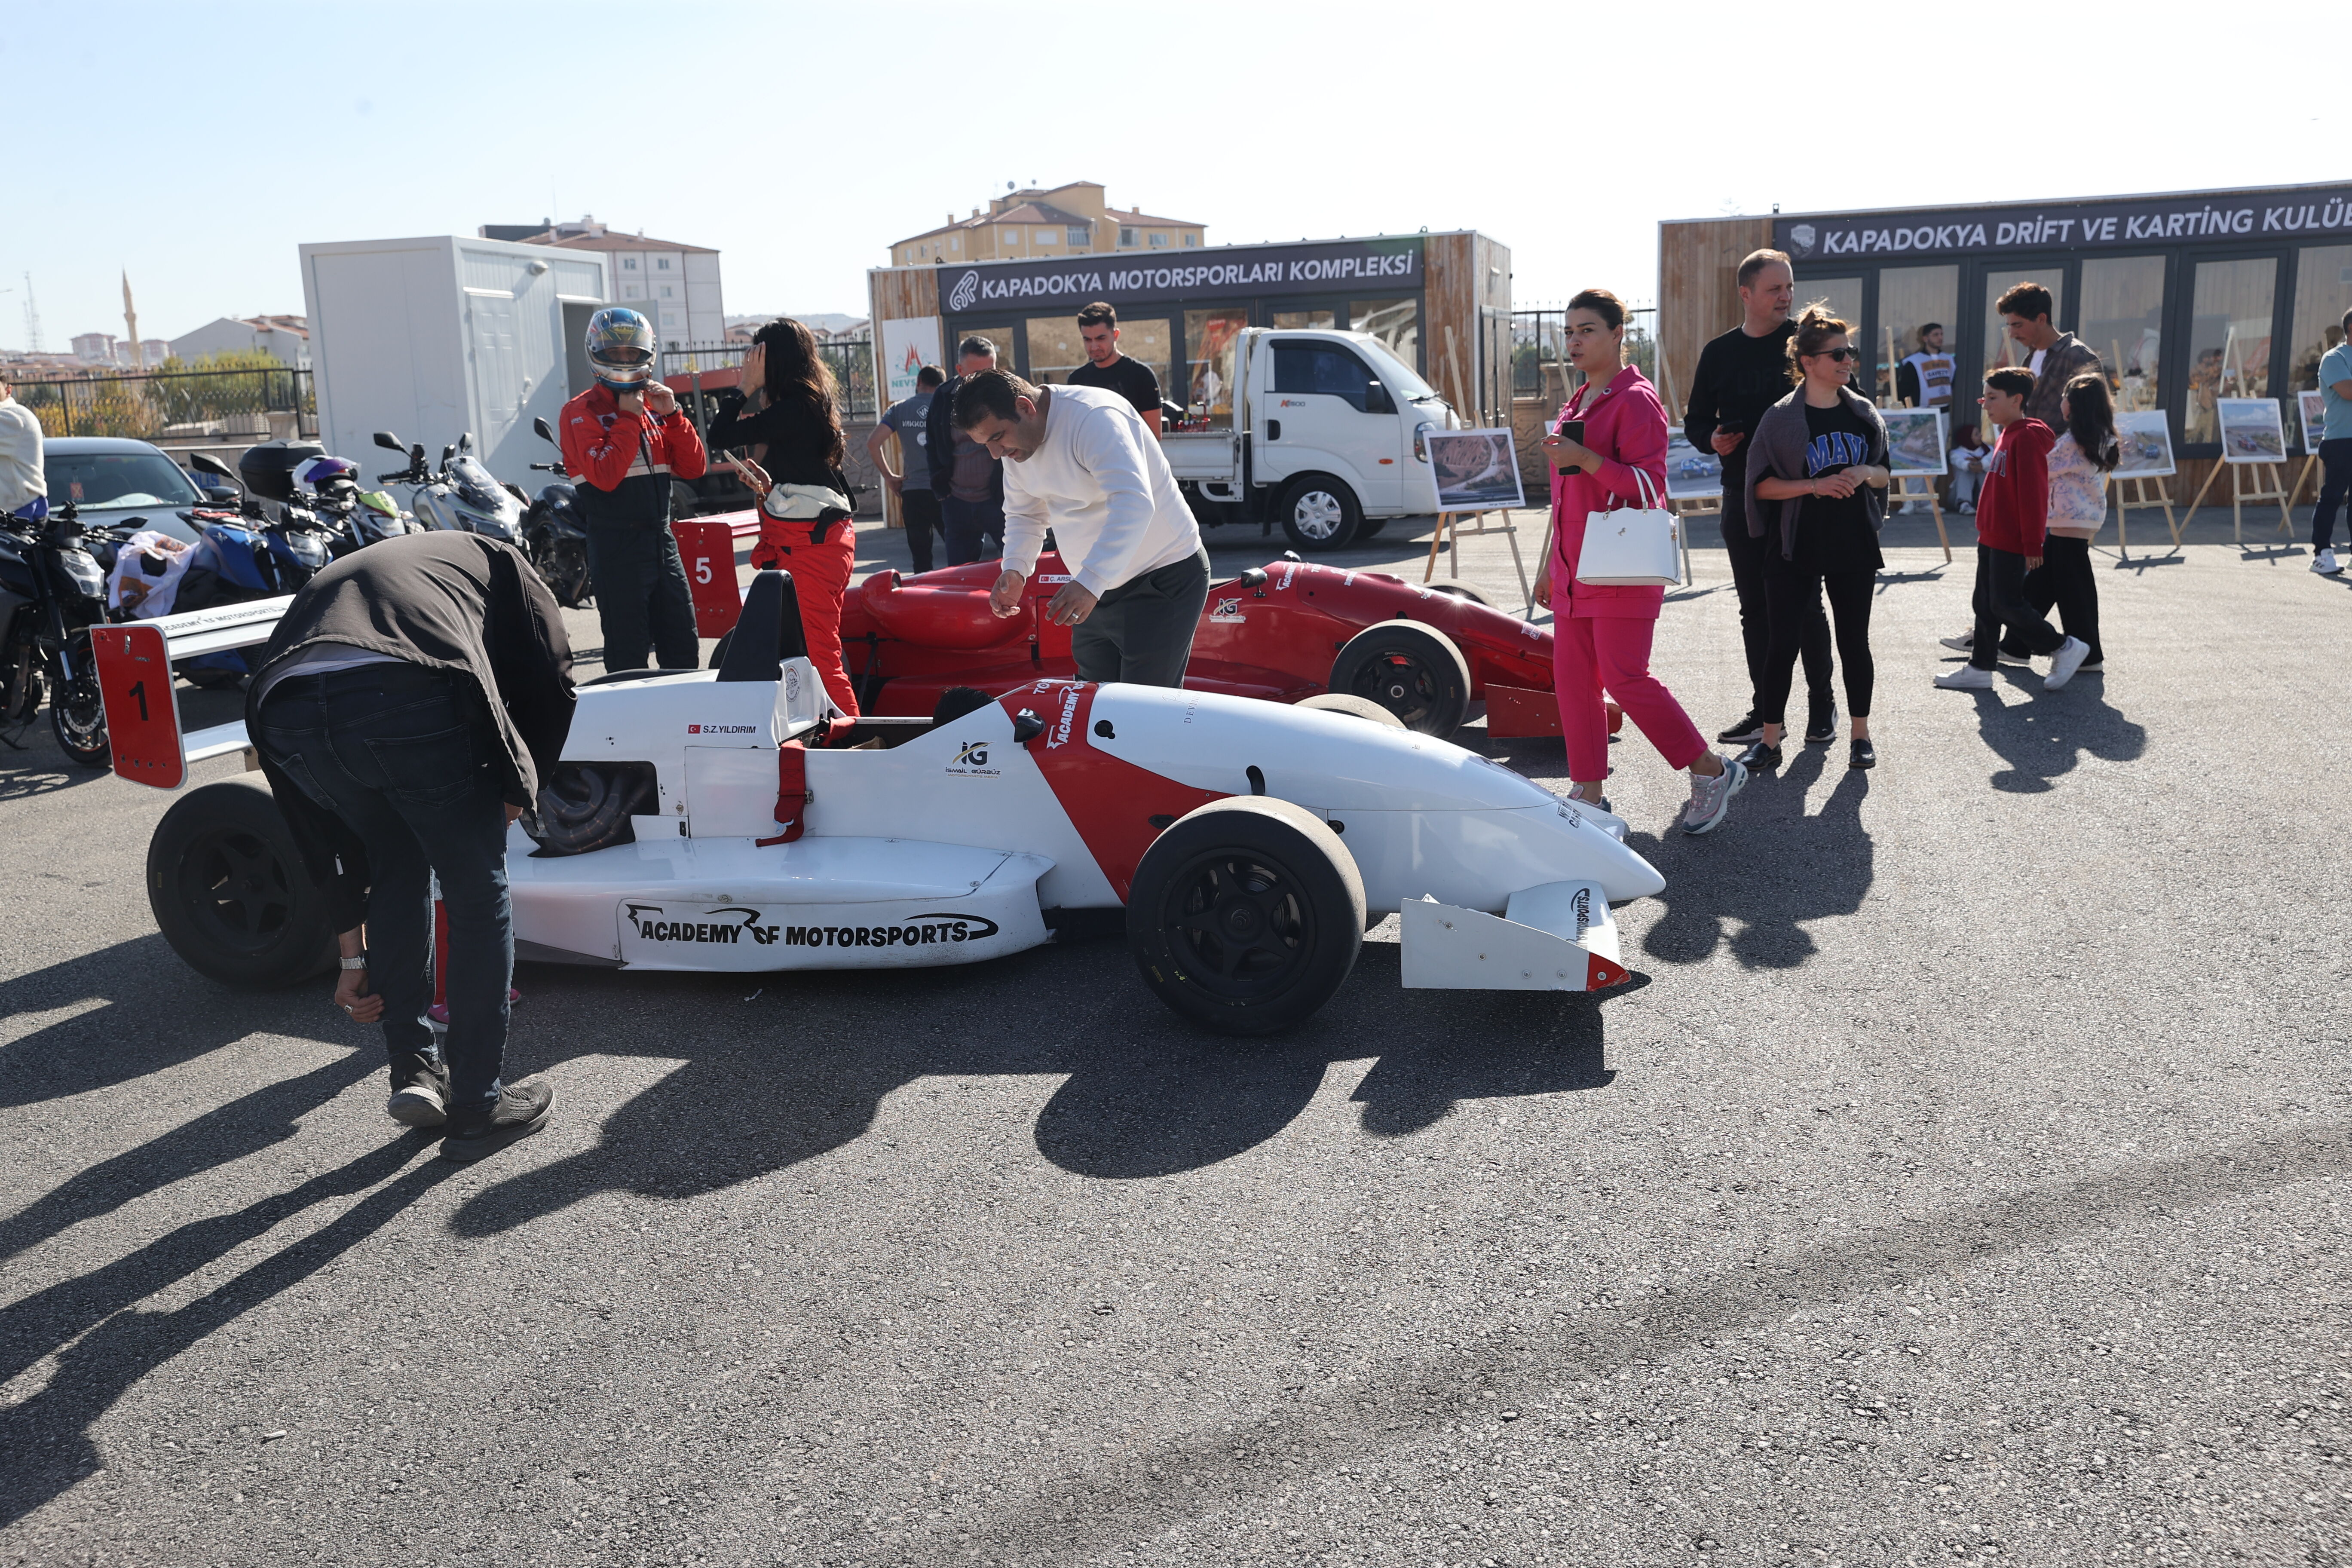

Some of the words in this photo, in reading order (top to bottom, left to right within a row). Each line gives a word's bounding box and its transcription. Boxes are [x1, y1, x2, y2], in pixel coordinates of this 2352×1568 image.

[1823, 224, 1987, 254] KAPADOKYA
[1996, 215, 2075, 244] DRİFT
[2082, 217, 2118, 241] VE
[2125, 205, 2253, 239] KARTİNG
[982, 273, 1102, 299] KAPADOKYA
[1109, 262, 1283, 290] MOTORSPORLARI
[1289, 249, 1413, 281] KOMPLEKSİ
[696, 557, 712, 584] 5
[215, 607, 278, 622] MOTORSPORTS
[129, 681, 149, 721] 1
[1057, 691, 1080, 744] ACADEMY
[641, 922, 742, 943] ACADEMY
[753, 925, 780, 944] OF
[786, 921, 968, 946] MOTORSPORTS
